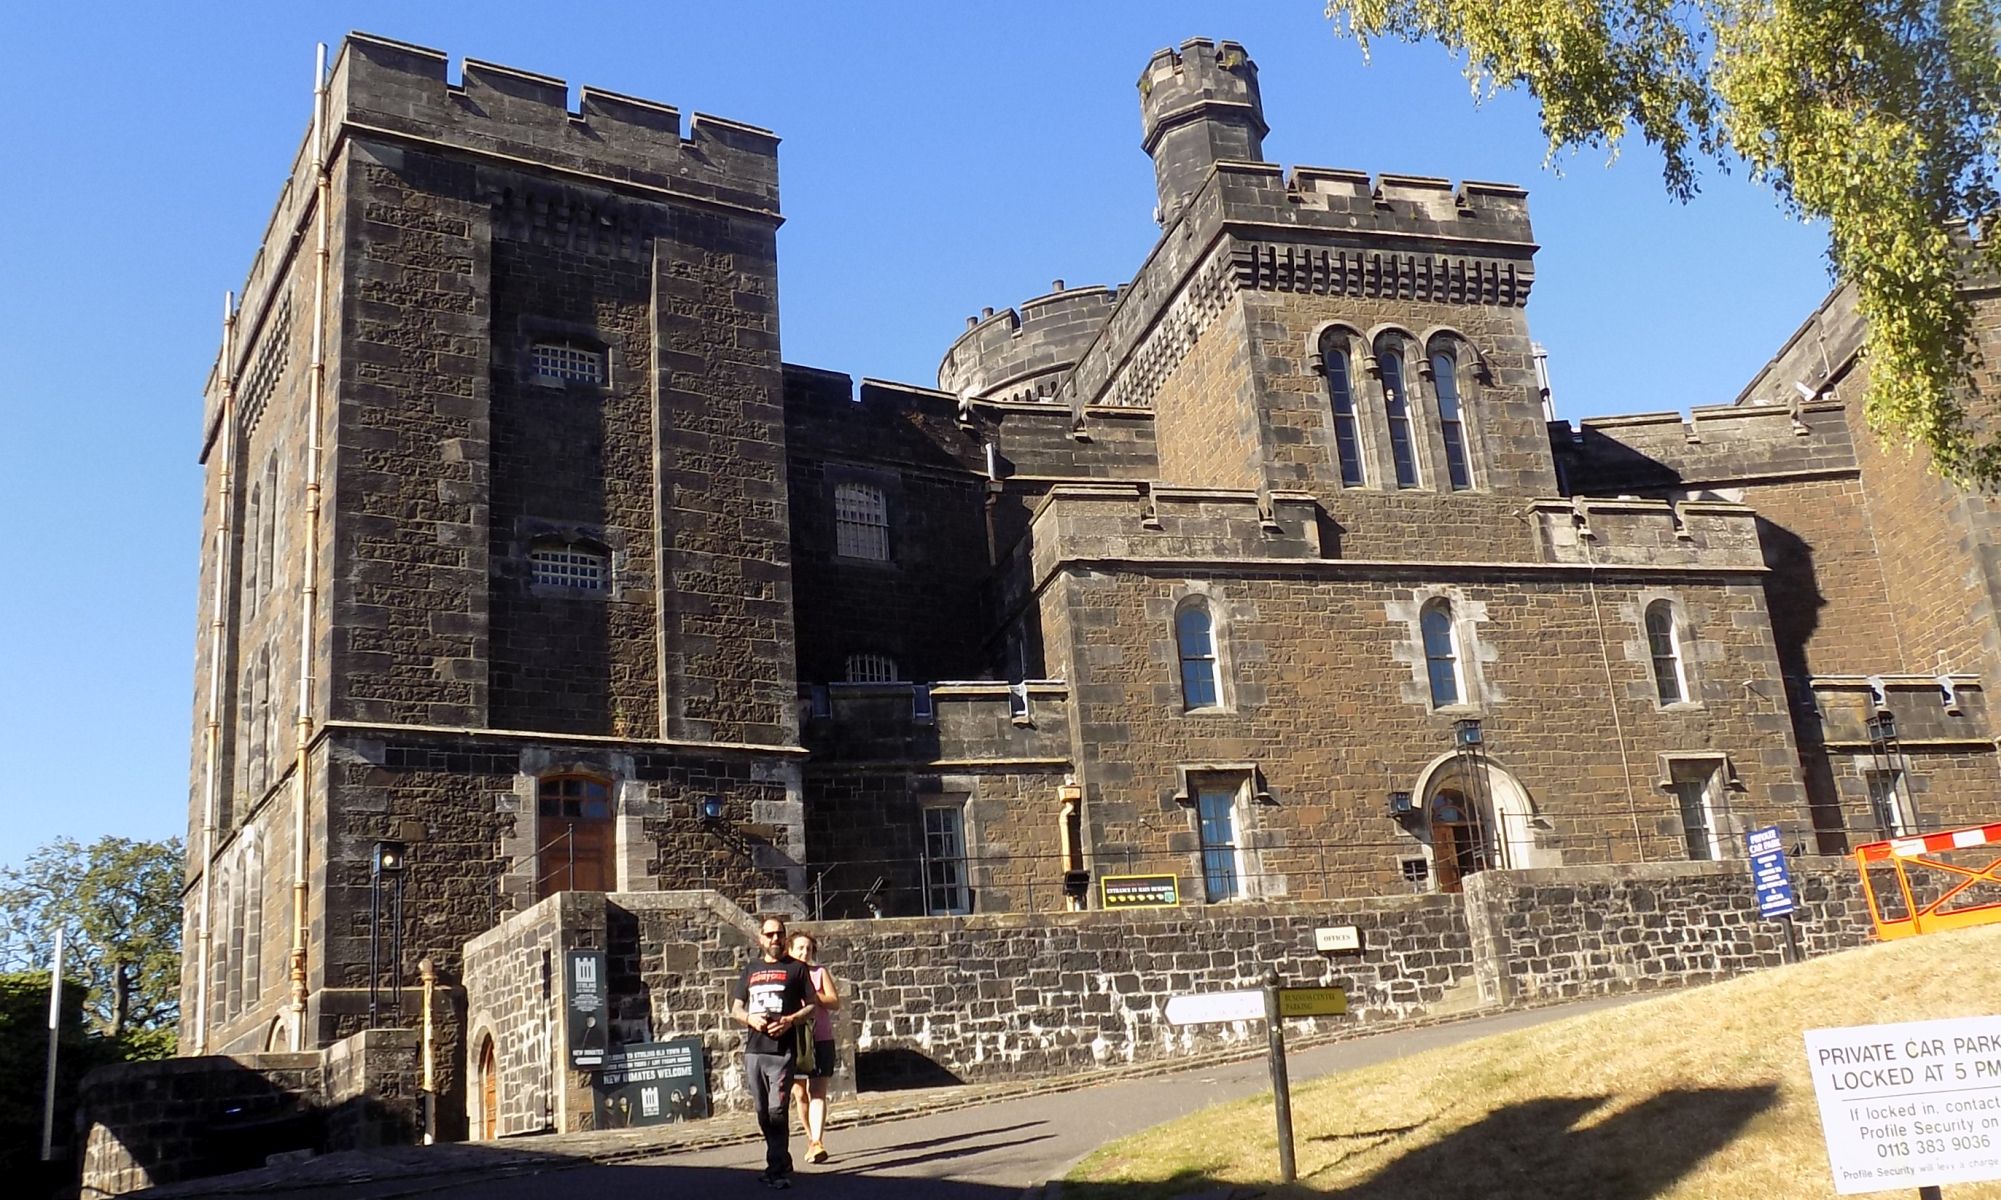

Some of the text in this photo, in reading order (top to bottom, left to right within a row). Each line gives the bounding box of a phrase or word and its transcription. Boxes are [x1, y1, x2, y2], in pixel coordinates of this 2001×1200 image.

[1749, 838, 1781, 854] CAR PARK
[1323, 934, 1351, 942] OFFICES
[1818, 1034, 2001, 1066] PRIVATE CAR PARK
[603, 1074, 620, 1085] NEW
[657, 1066, 693, 1079] WELCOME
[1832, 1060, 2001, 1090] LOCKED AT 5 PM
[1849, 1108, 1859, 1121] If
[1866, 1103, 1916, 1120] locked
[1945, 1096, 2001, 1113] contact
[1859, 1117, 1999, 1140] Profile Security on
[1877, 1134, 1991, 1158] 0113 383 9036
[1877, 1165, 1915, 1177] Security
